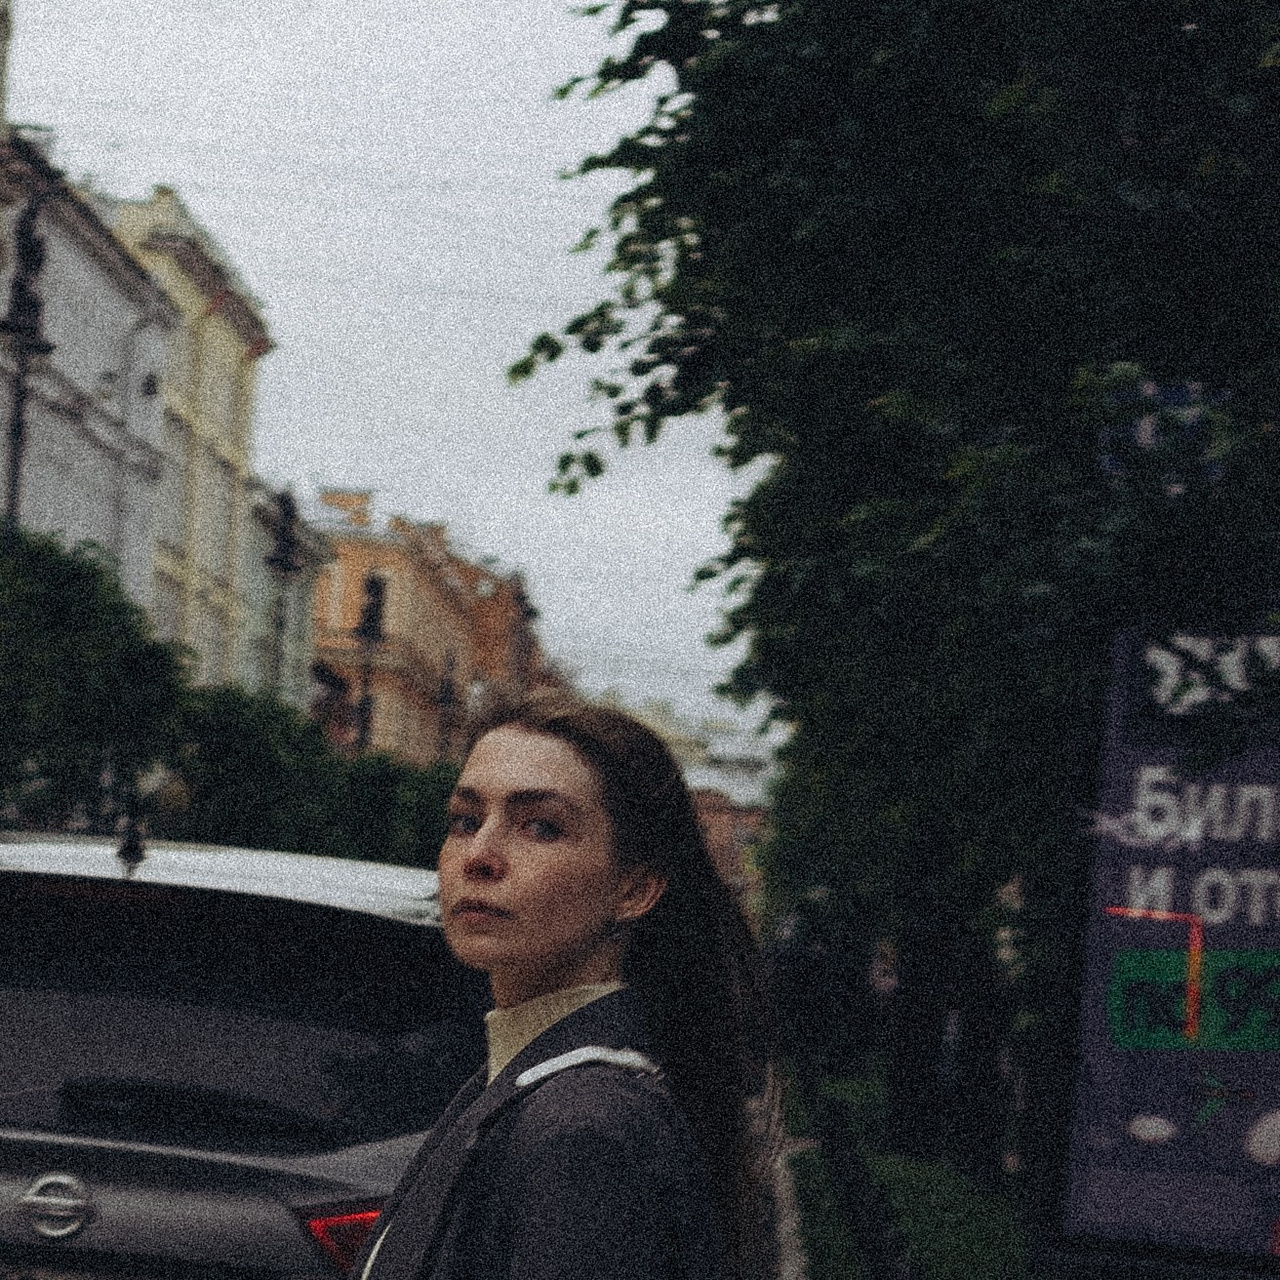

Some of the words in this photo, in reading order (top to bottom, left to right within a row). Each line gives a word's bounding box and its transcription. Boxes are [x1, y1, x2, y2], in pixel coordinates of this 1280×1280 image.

[1135, 765, 1280, 842] Бил
[1130, 866, 1173, 924] и
[1193, 868, 1280, 928] от
